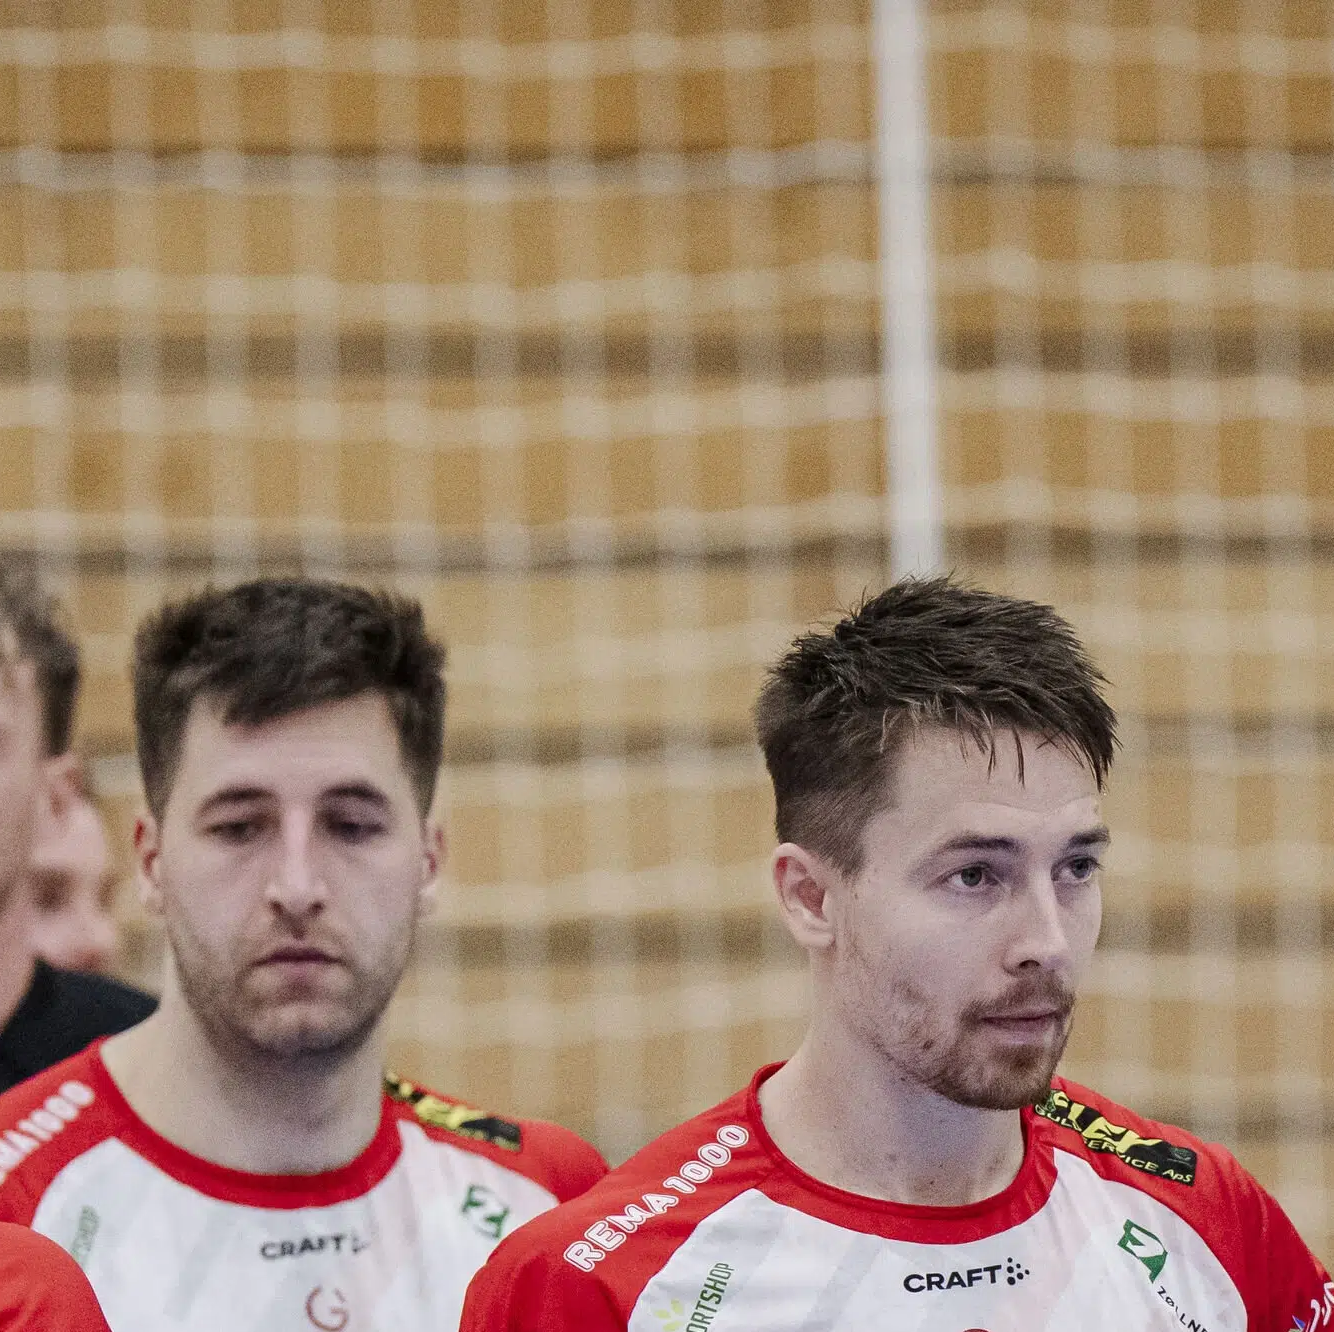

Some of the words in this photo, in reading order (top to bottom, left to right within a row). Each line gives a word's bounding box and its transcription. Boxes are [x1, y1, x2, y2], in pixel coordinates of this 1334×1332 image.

[563, 1193, 679, 1272] REMA
[663, 1124, 750, 1194] 1000
[903, 1264, 1003, 1293] CRAFT
